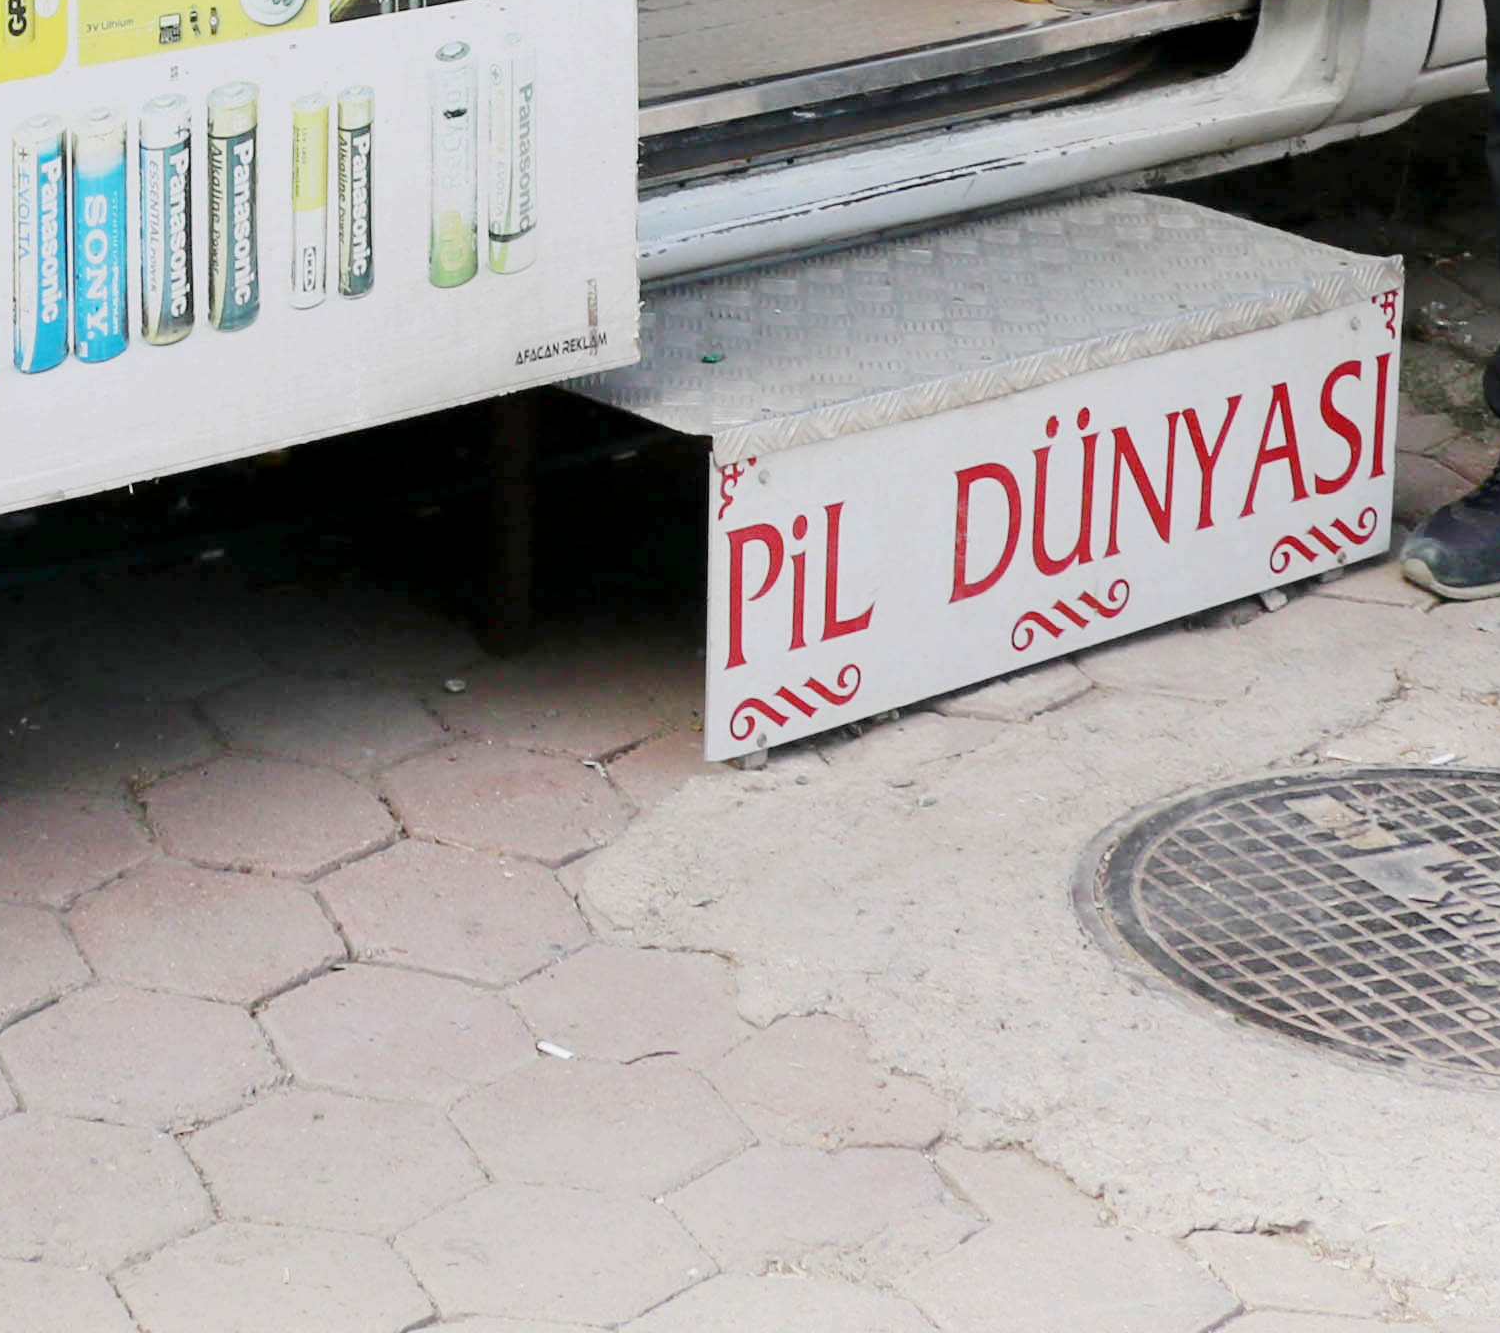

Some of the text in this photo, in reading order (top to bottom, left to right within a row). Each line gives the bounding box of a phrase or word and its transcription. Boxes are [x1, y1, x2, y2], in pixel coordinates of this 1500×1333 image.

[41, 157, 62, 323] Panasonic
[84, 195, 108, 340] SONY
[169, 147, 190, 318] Panasonic
[233, 139, 254, 306] Panasonic
[352, 133, 371, 276] Panasonic
[515, 343, 560, 365] AFACAN
[948, 352, 1391, 604] DÜNYASI
